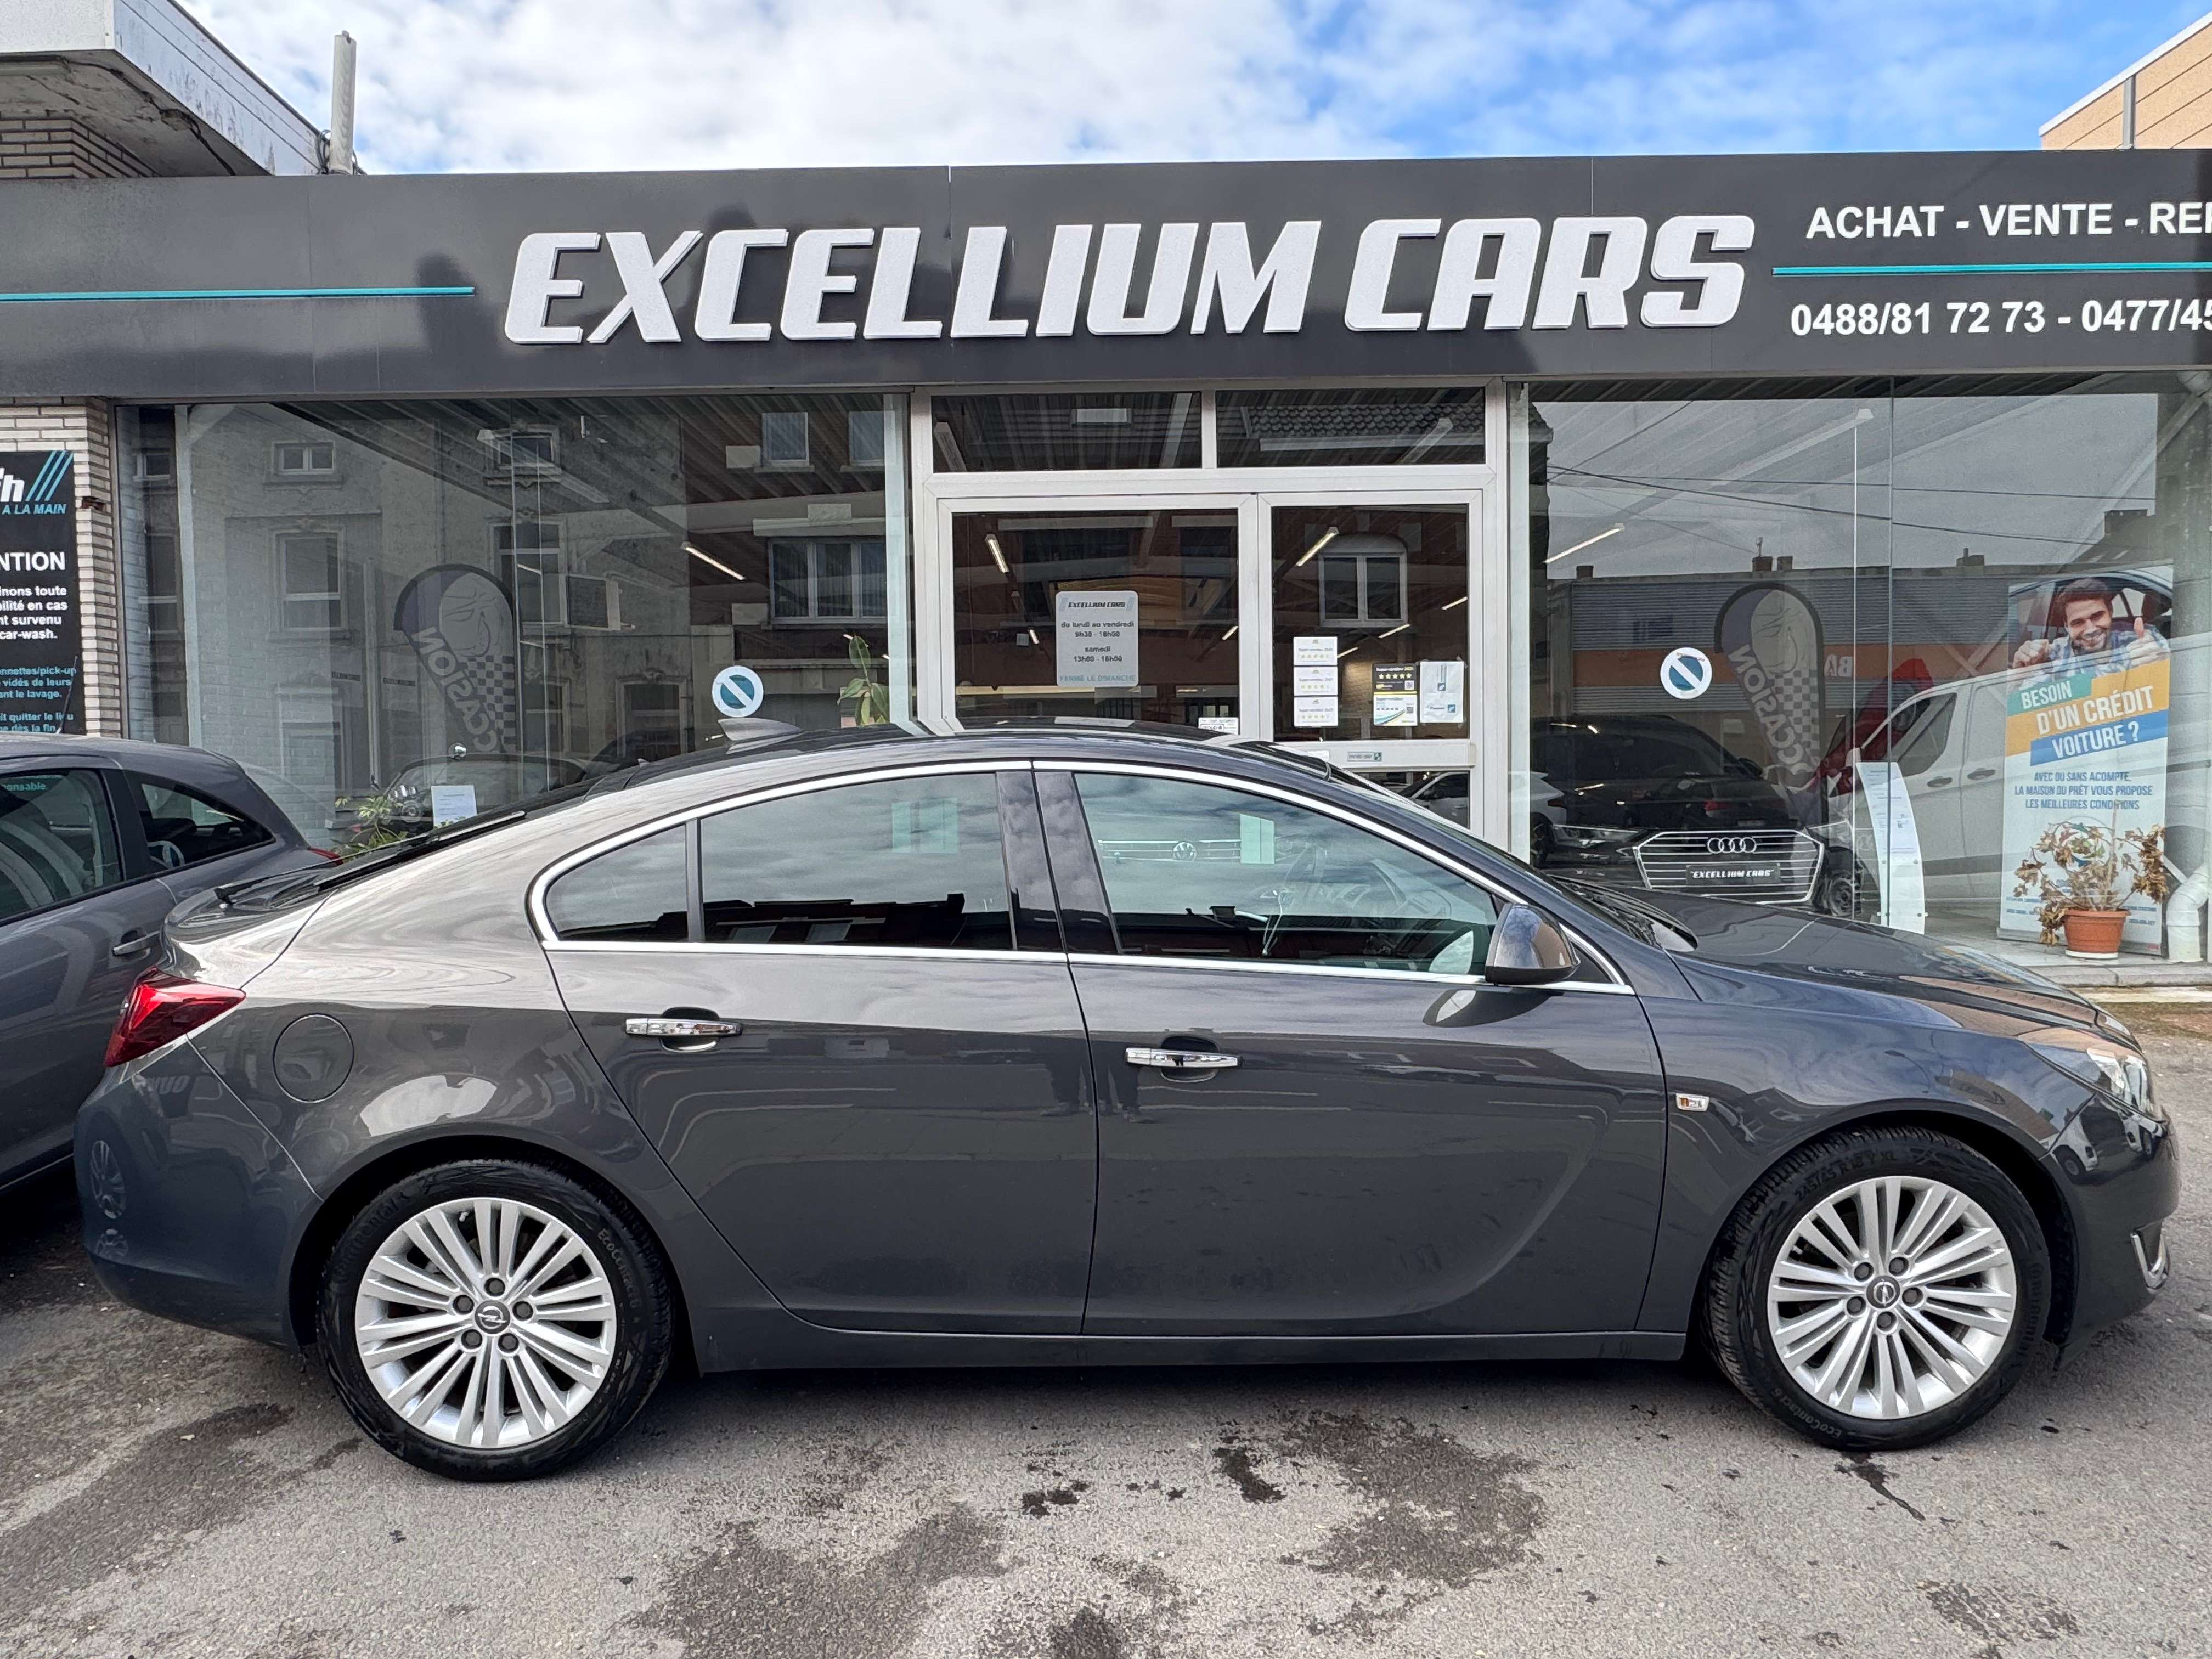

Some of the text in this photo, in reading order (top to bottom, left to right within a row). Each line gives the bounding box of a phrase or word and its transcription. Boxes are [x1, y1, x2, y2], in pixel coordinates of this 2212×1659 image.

[1806, 205, 1944, 238] ACHAT
[1980, 203, 2113, 236] VENTE
[504, 215, 1755, 343] EXCELLIUM CARS
[1791, 303, 1931, 336] 0488/81
[1946, 303, 1989, 334] 72
[2002, 301, 2045, 332] 73
[2, 504, 67, 515] A LA MAIN
[35, 585, 67, 596] toute
[27, 601, 43, 611] en
[46, 601, 68, 611] cas
[12, 616, 61, 625] survenu
[0, 628, 58, 640] car-wash.
[32, 678, 44, 687] de
[47, 677, 71, 687] leurs
[15, 690, 24, 698] le
[27, 690, 62, 700] lavage.
[2021, 680, 2072, 710] BESOIN
[2036, 685, 2154, 735] D'UN CRÉDIT
[9, 713, 42, 723] quitter
[44, 712, 53, 720] le
[2052, 721, 2140, 758] VOITURE ?
[2034, 771, 2131, 782] AVEC OU SANS ACOMPTE,
[2015, 785, 2153, 795] LA MAISON DU PRÊT VOUS PROPOSE
[2025, 799, 2039, 809] LES
[2041, 799, 2087, 809] MEILLEURES
